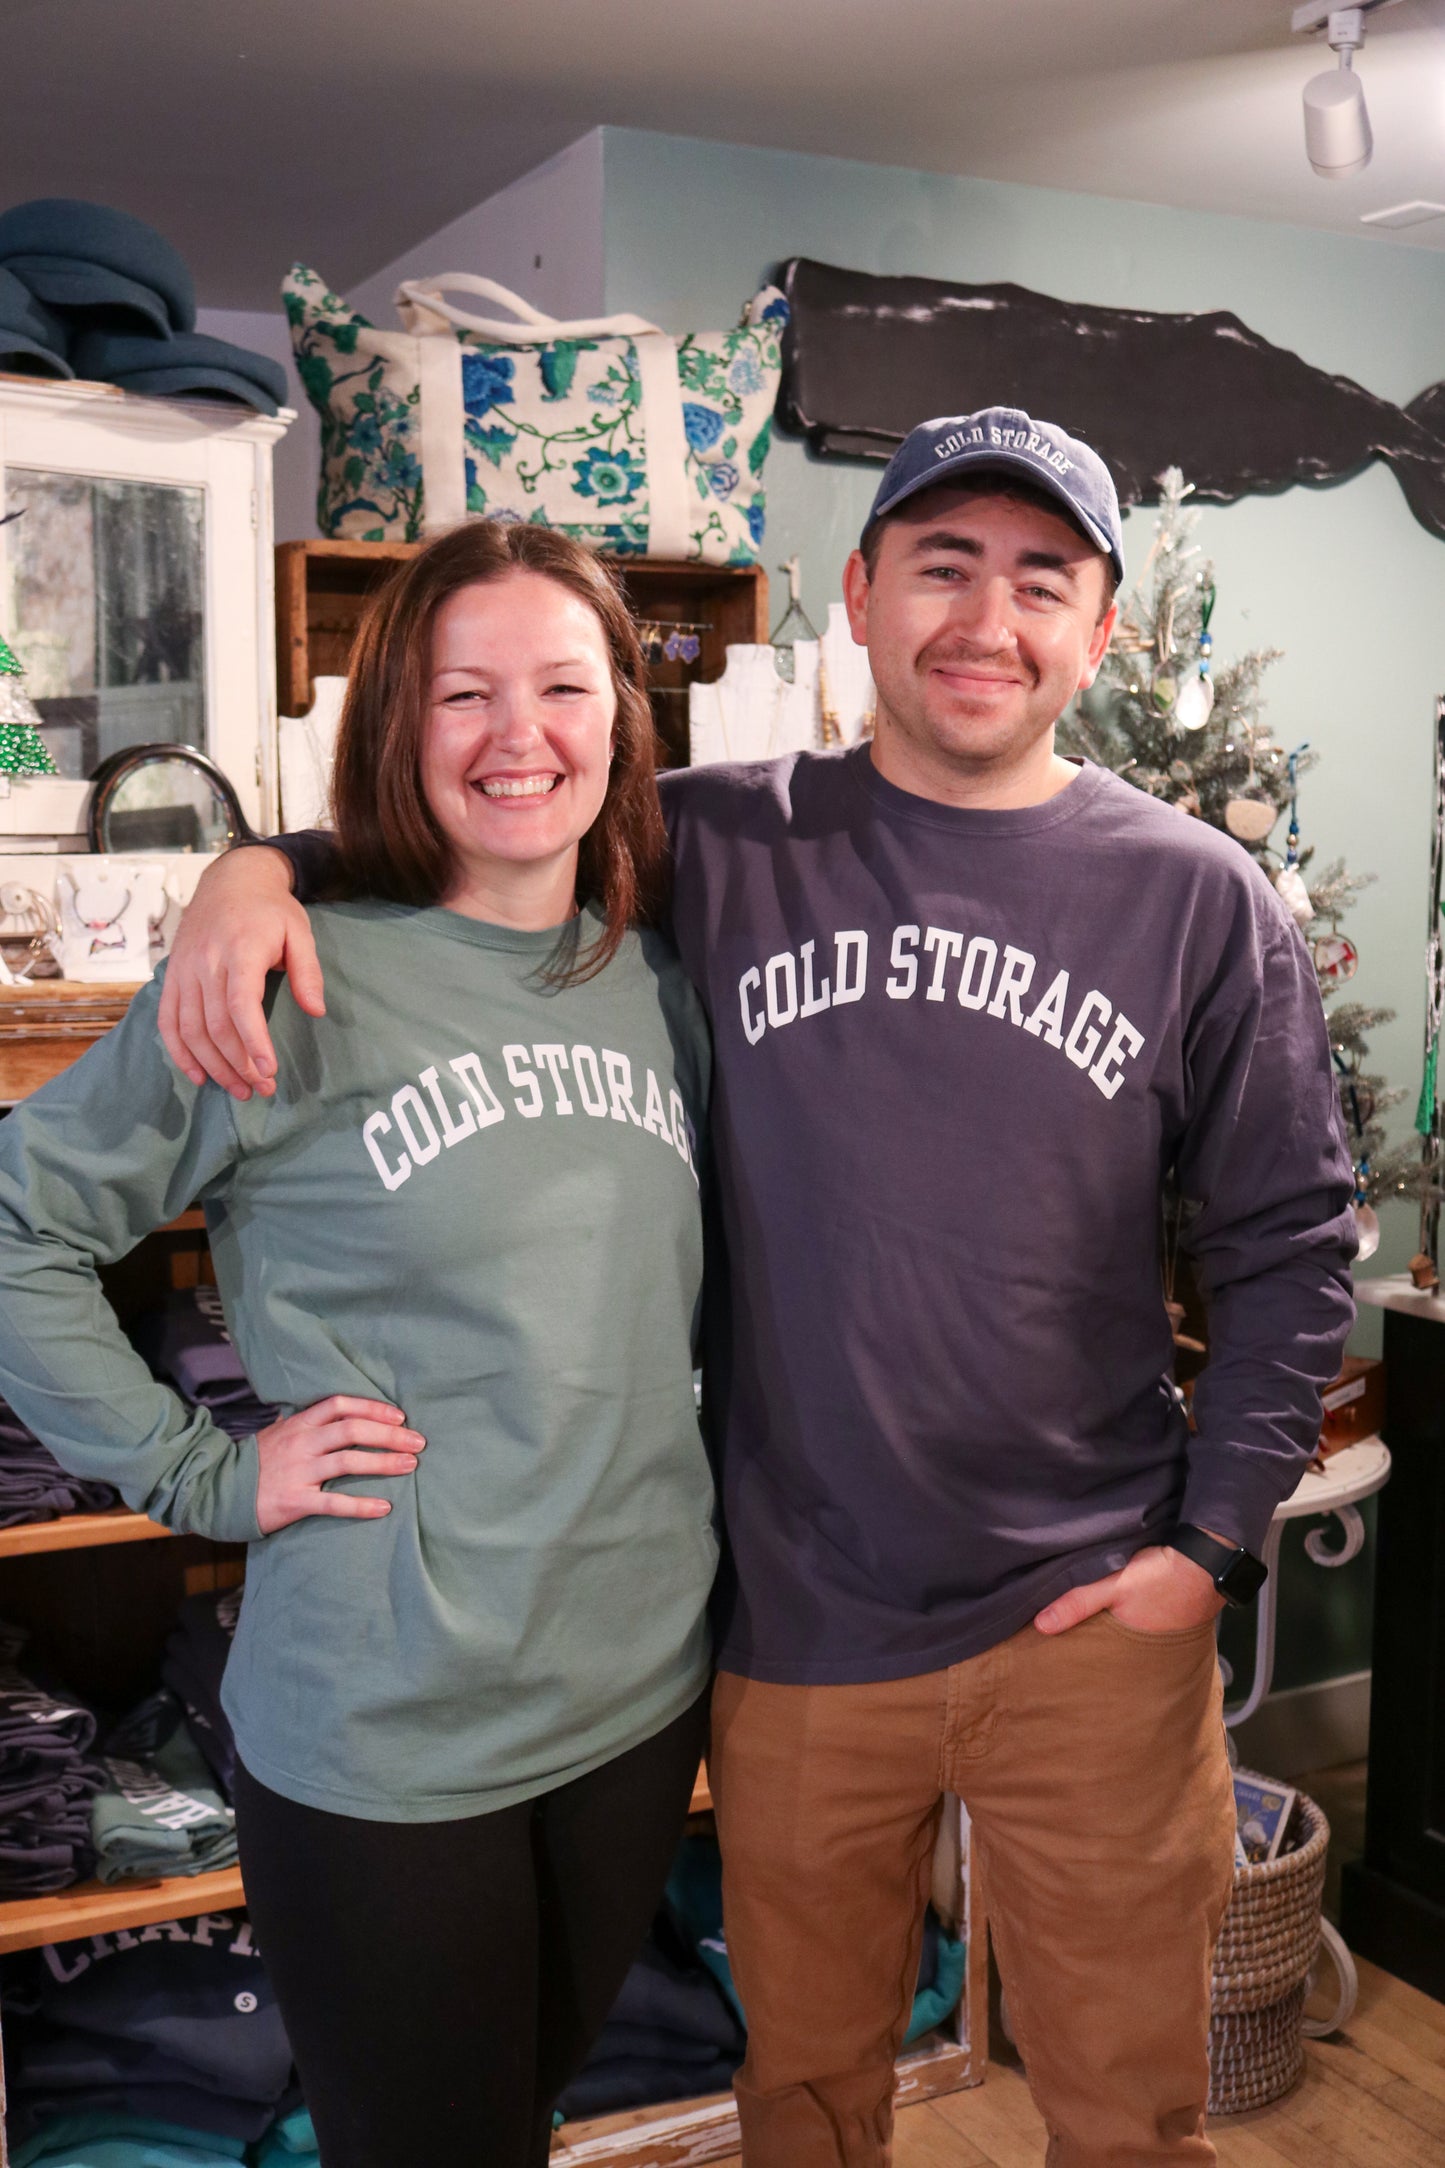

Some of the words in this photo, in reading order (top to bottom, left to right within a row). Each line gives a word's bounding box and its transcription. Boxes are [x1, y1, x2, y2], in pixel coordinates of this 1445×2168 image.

[934, 426, 984, 459] COLD
[990, 426, 1074, 475] STORAGE
[739, 930, 869, 1047] COLD
[886, 924, 1146, 1100] STORAGE
[362, 1052, 506, 1192] COLD
[502, 1044, 700, 1190] STORAG
